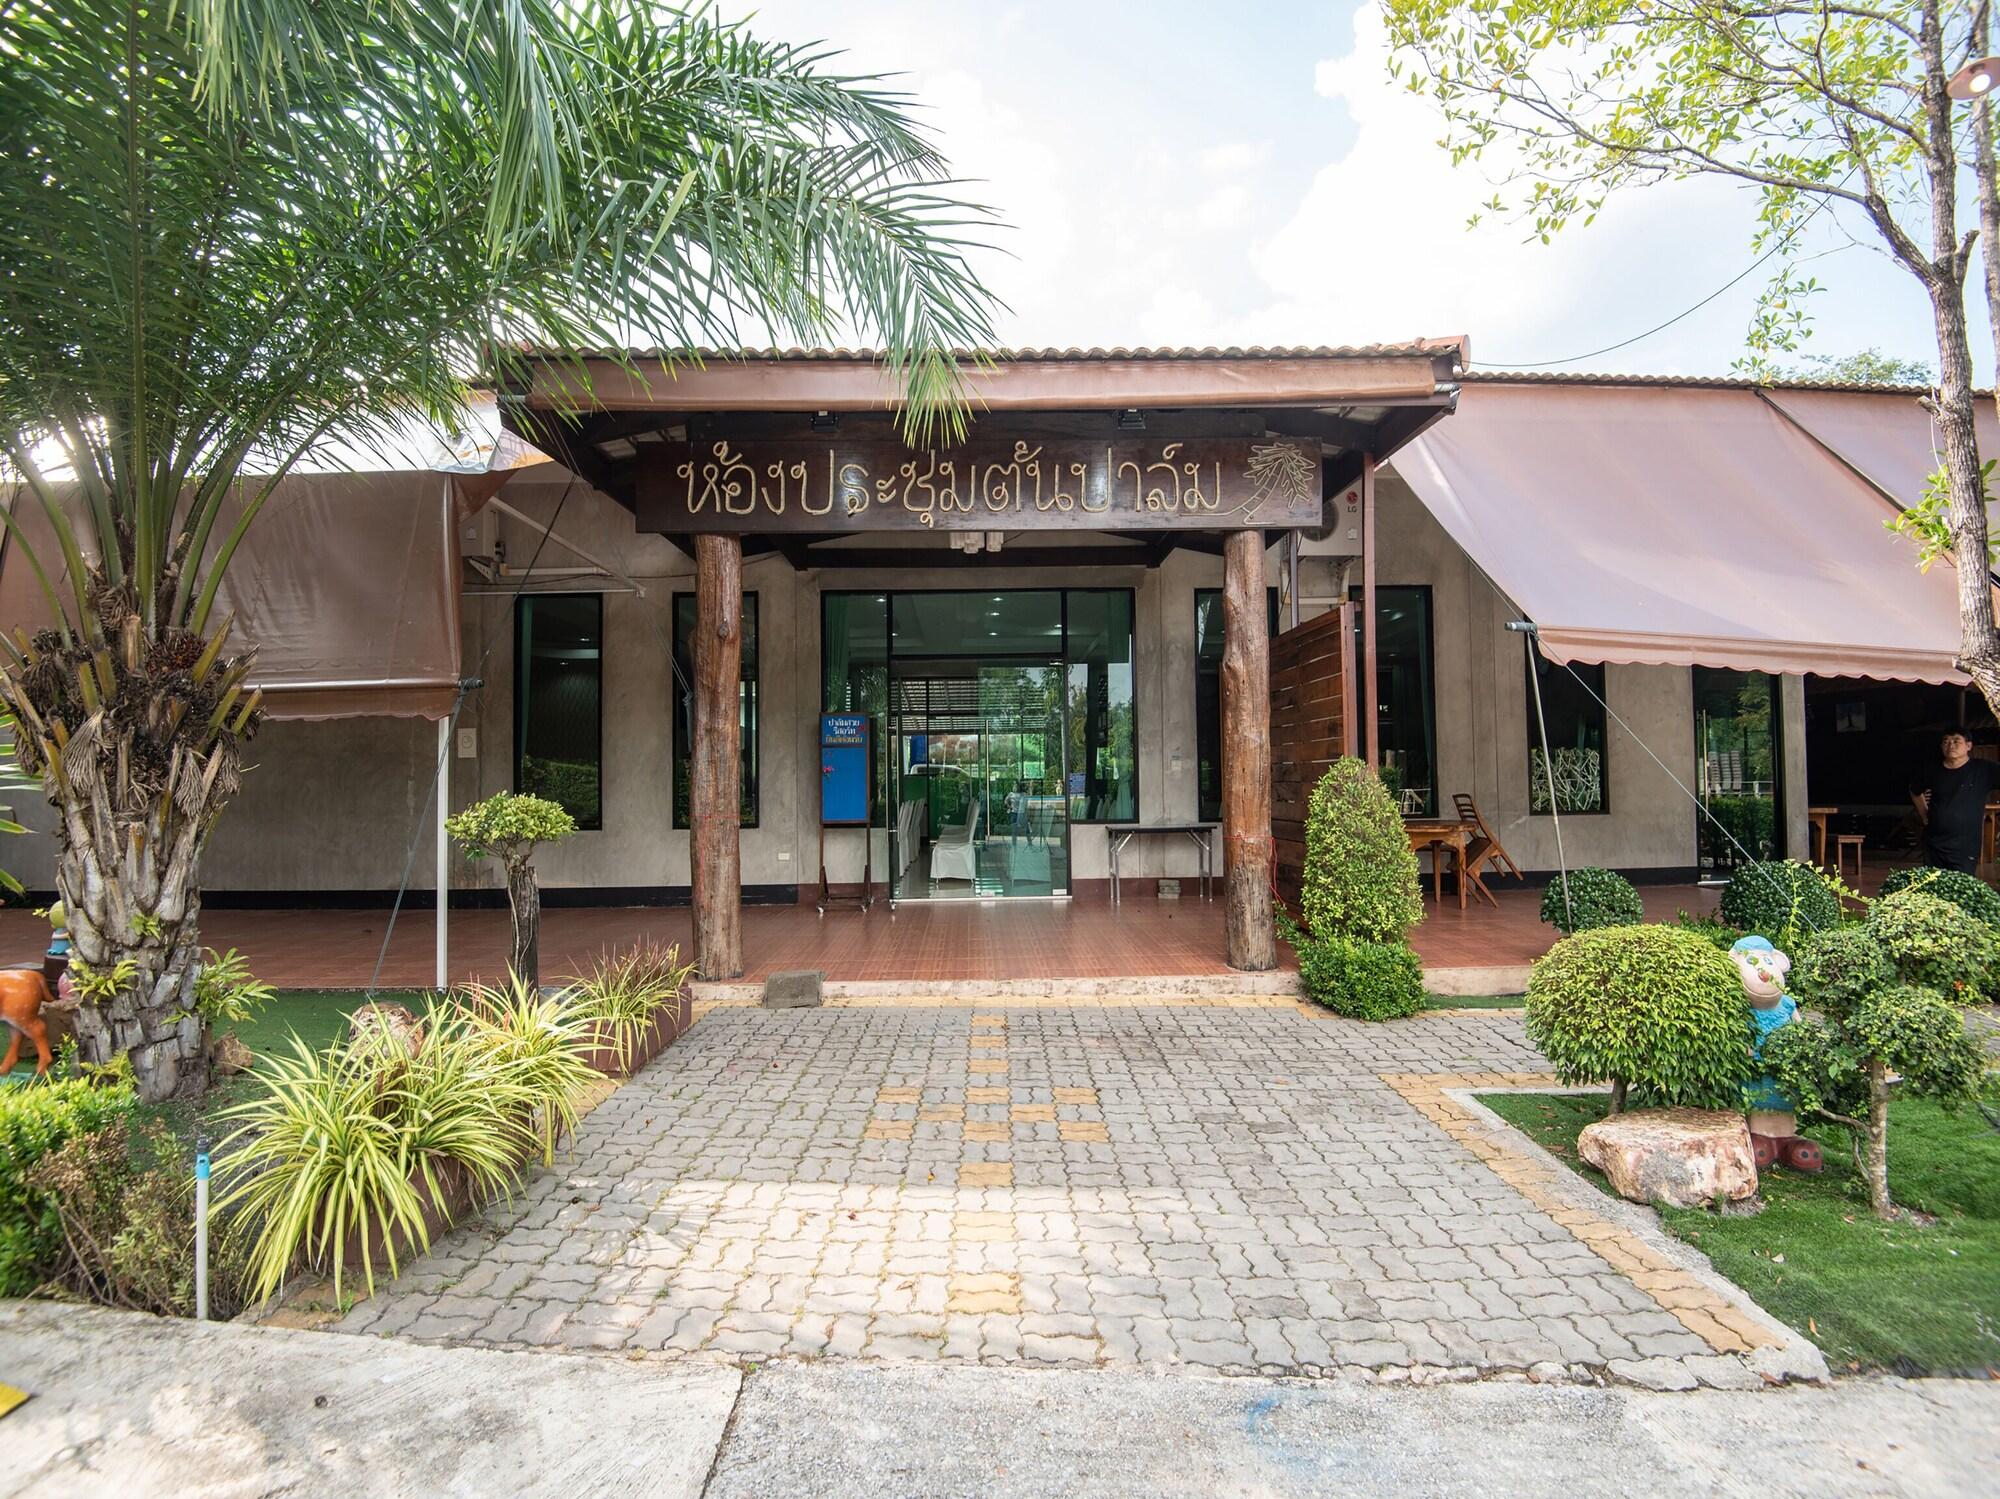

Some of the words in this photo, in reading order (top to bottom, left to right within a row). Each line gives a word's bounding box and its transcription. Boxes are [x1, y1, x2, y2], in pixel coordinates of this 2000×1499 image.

[677, 440, 1221, 528] ห้องประชุมต้นปาล์ม
